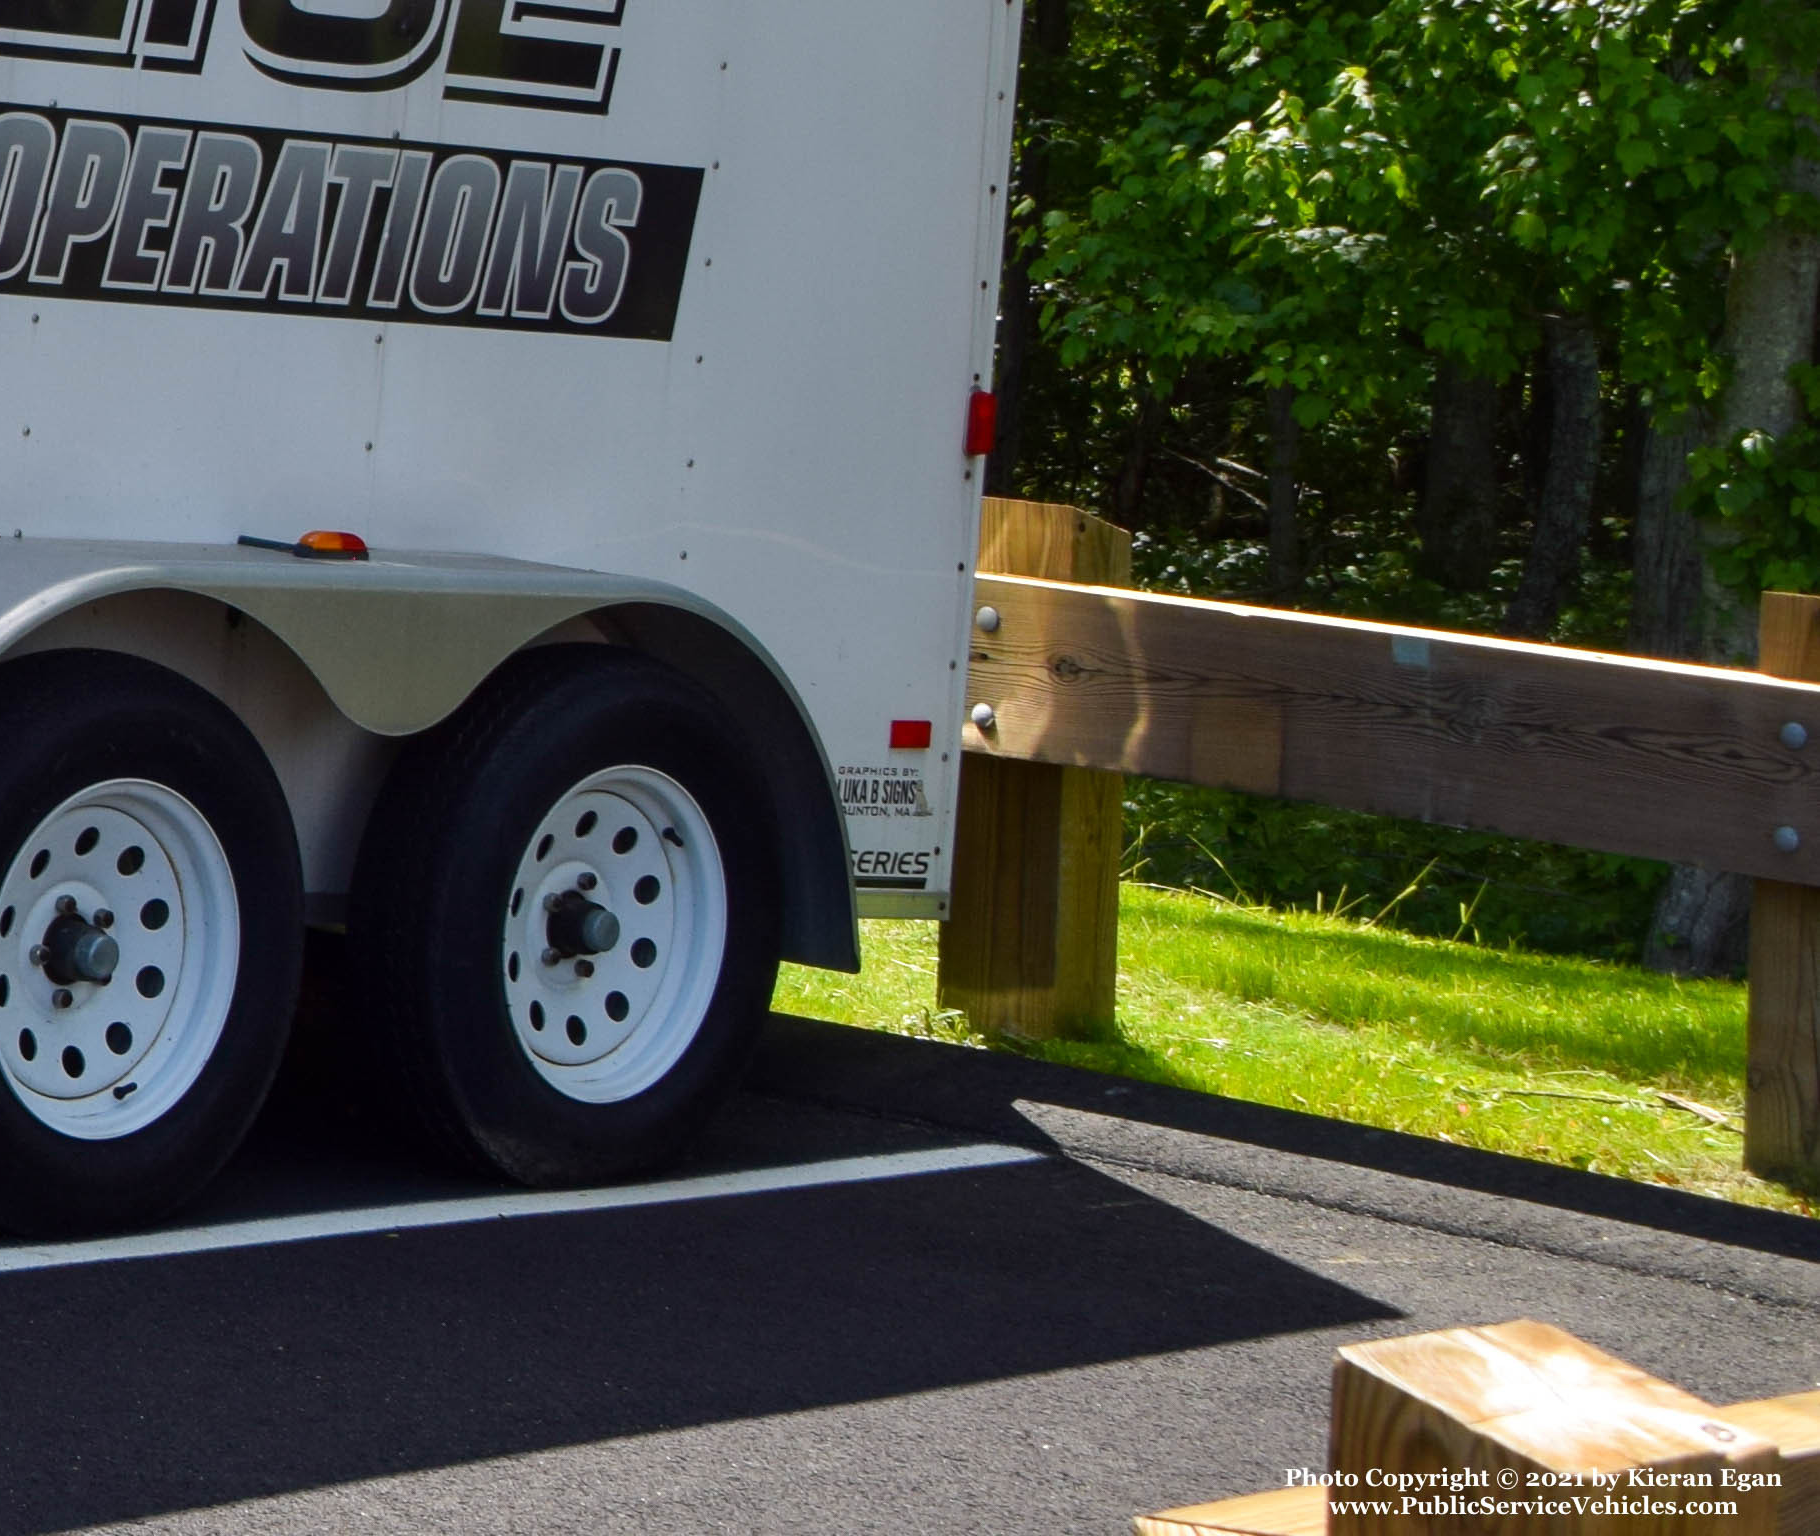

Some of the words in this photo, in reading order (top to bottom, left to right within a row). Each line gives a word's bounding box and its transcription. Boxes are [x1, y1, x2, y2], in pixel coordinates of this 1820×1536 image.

[838, 766, 898, 776] GRAPHICS
[902, 767, 919, 777] BY:
[871, 779, 880, 804] B
[881, 779, 918, 805] SIGNS
[894, 807, 910, 817] MA
